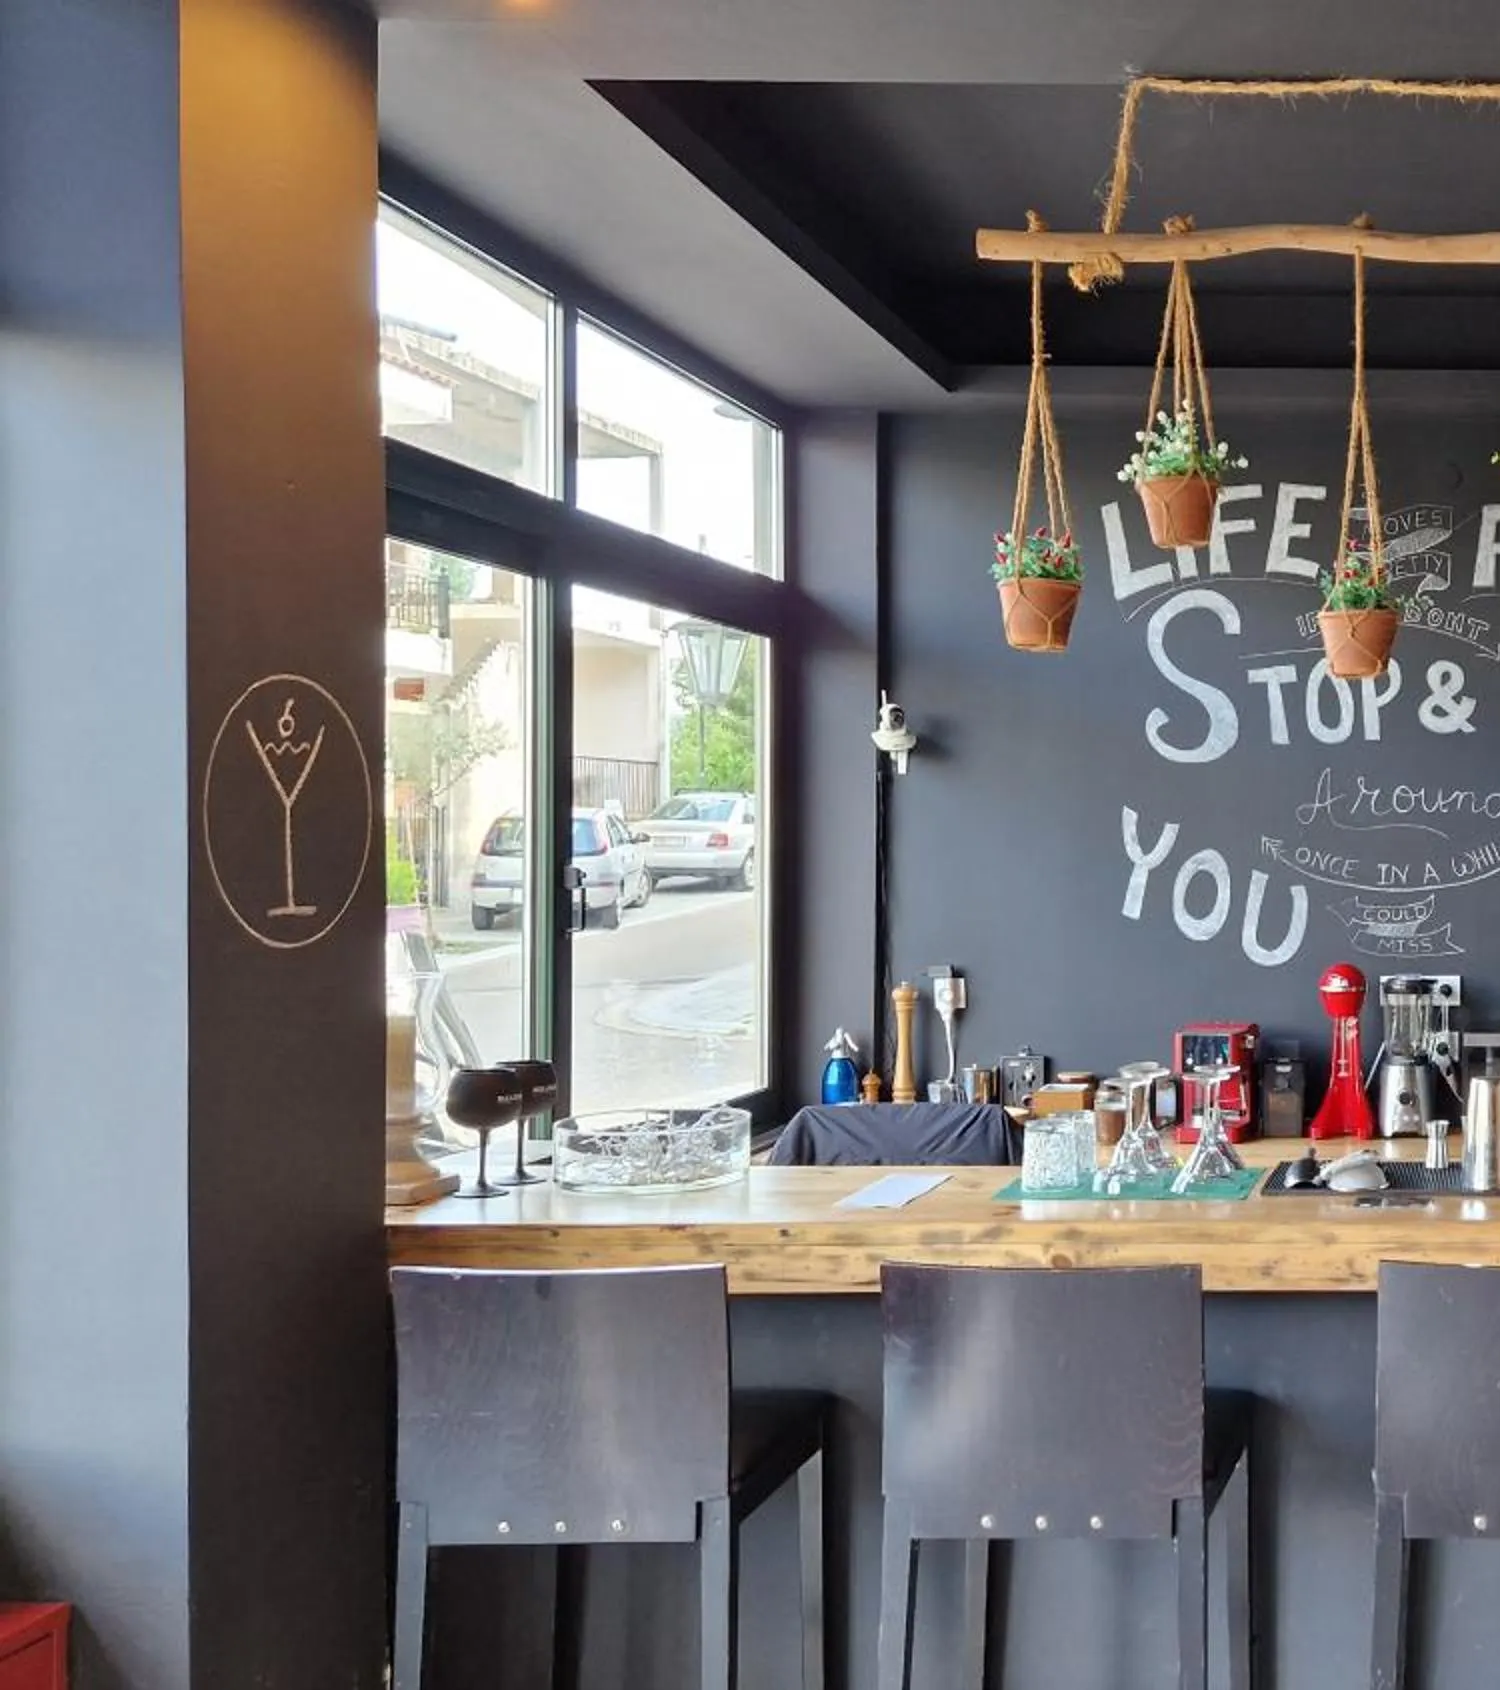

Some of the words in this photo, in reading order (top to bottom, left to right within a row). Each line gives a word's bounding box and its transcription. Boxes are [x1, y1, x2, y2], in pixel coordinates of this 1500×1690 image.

[1363, 508, 1442, 541] OVES
[1417, 659, 1478, 735] &
[1295, 847, 1360, 879] ONCE
[1376, 862, 1409, 885] IN
[1422, 862, 1442, 885] A
[1122, 805, 1308, 966] YOU
[1362, 905, 1428, 922] COULD
[1377, 937, 1433, 953] MISS
